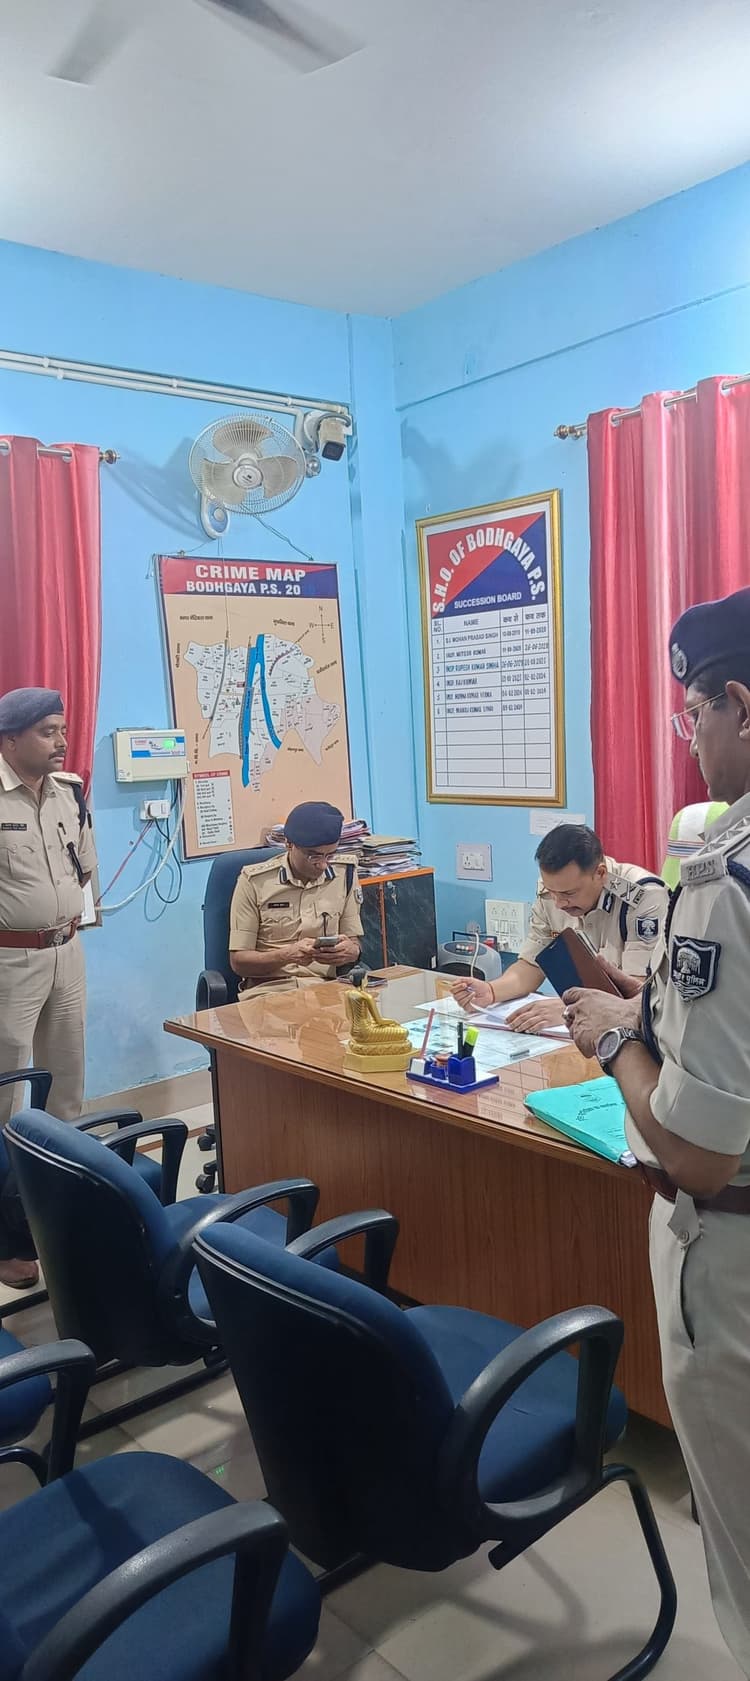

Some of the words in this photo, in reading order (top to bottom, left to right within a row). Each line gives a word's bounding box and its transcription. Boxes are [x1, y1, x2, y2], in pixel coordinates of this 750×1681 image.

[196, 564, 260, 580] CRIME
[266, 569, 306, 582] MAP
[432, 567, 455, 612] S.H.O.
[449, 540, 466, 566] OF
[466, 527, 536, 571] BODHGAYA
[527, 566, 546, 600] P.S.
[186, 580, 256, 594] BODHGAYA
[260, 583, 281, 594] P.S.
[285, 584, 301, 595] 20
[454, 595, 496, 609] SUCCESSION
[497, 591, 522, 604] BOARD
